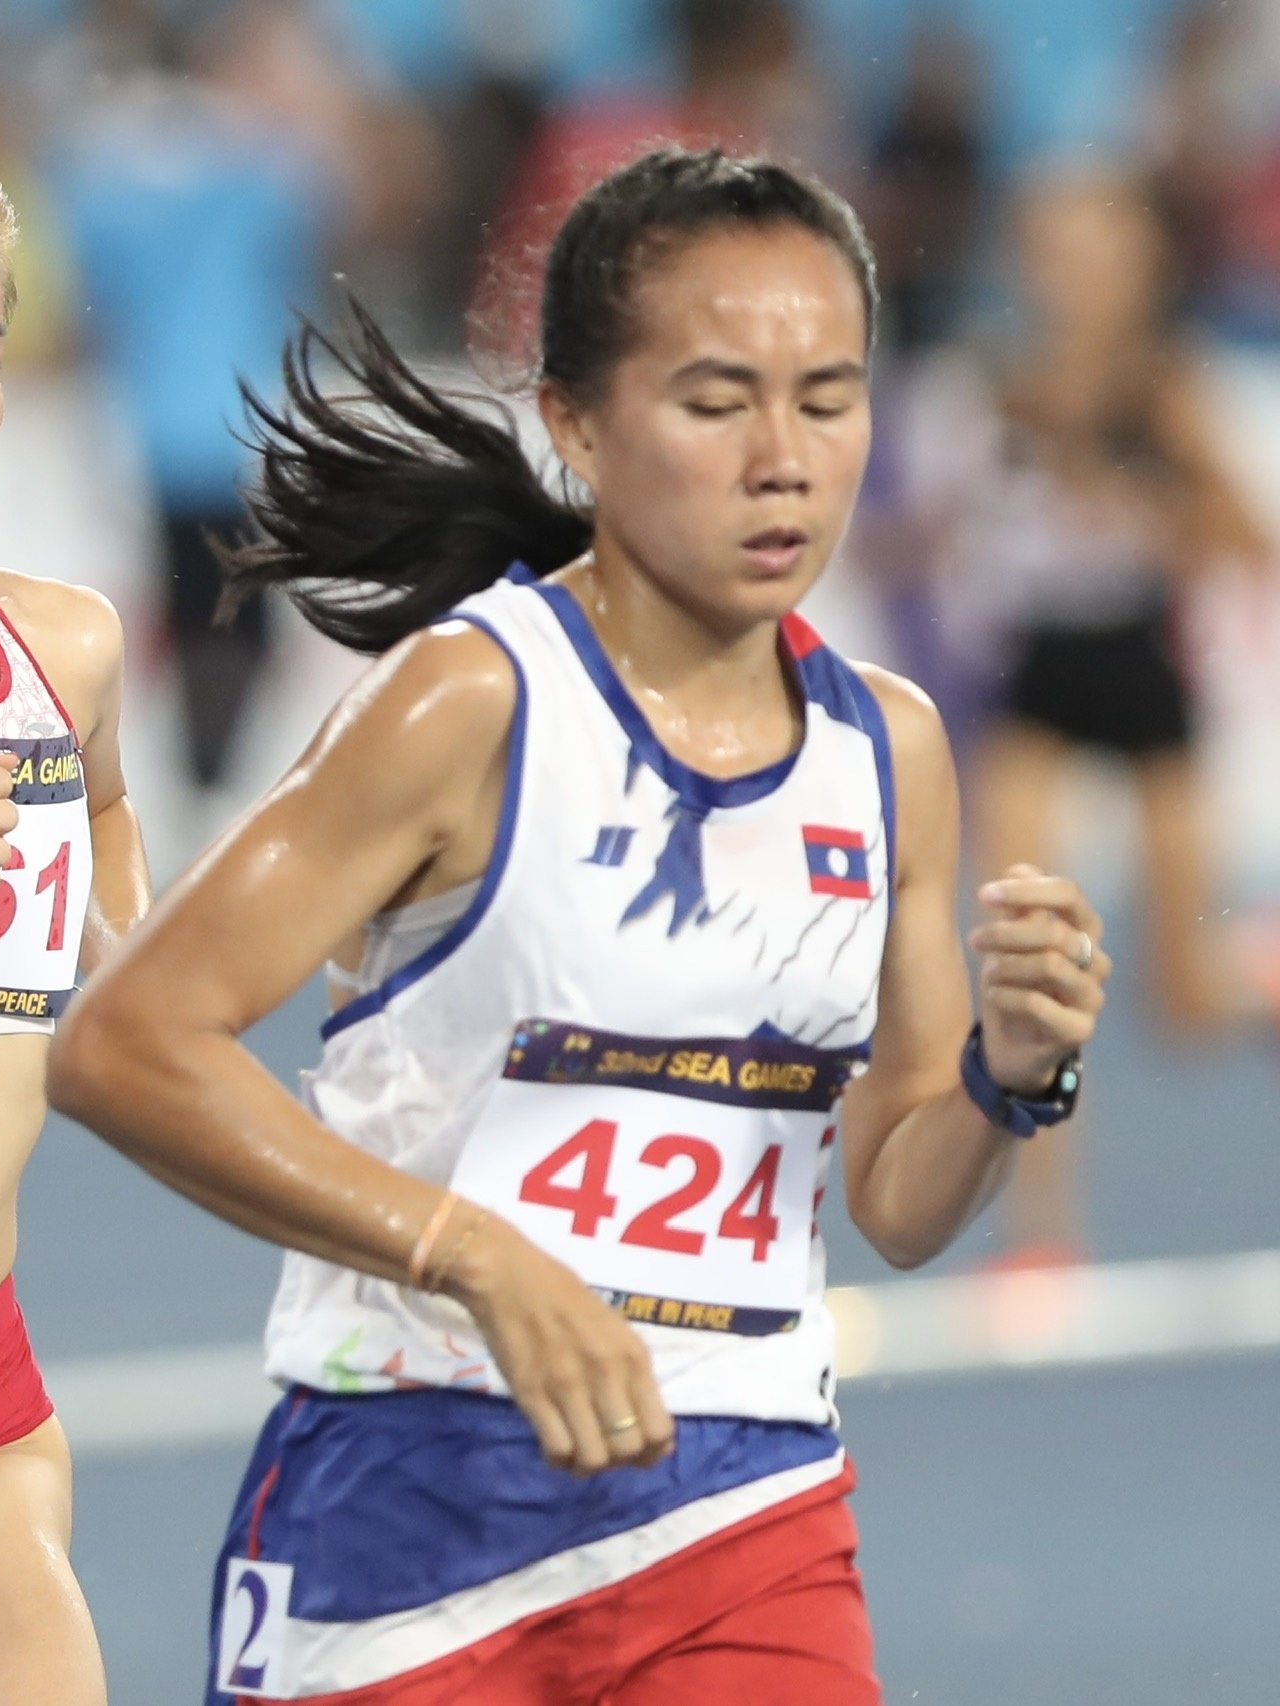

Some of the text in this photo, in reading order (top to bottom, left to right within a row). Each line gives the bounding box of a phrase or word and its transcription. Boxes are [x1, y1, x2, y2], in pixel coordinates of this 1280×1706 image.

[667, 1050, 731, 1087] SEA
[738, 1060, 816, 1092] GAMES
[519, 1118, 782, 1262] 424
[228, 1569, 269, 1689] 2
